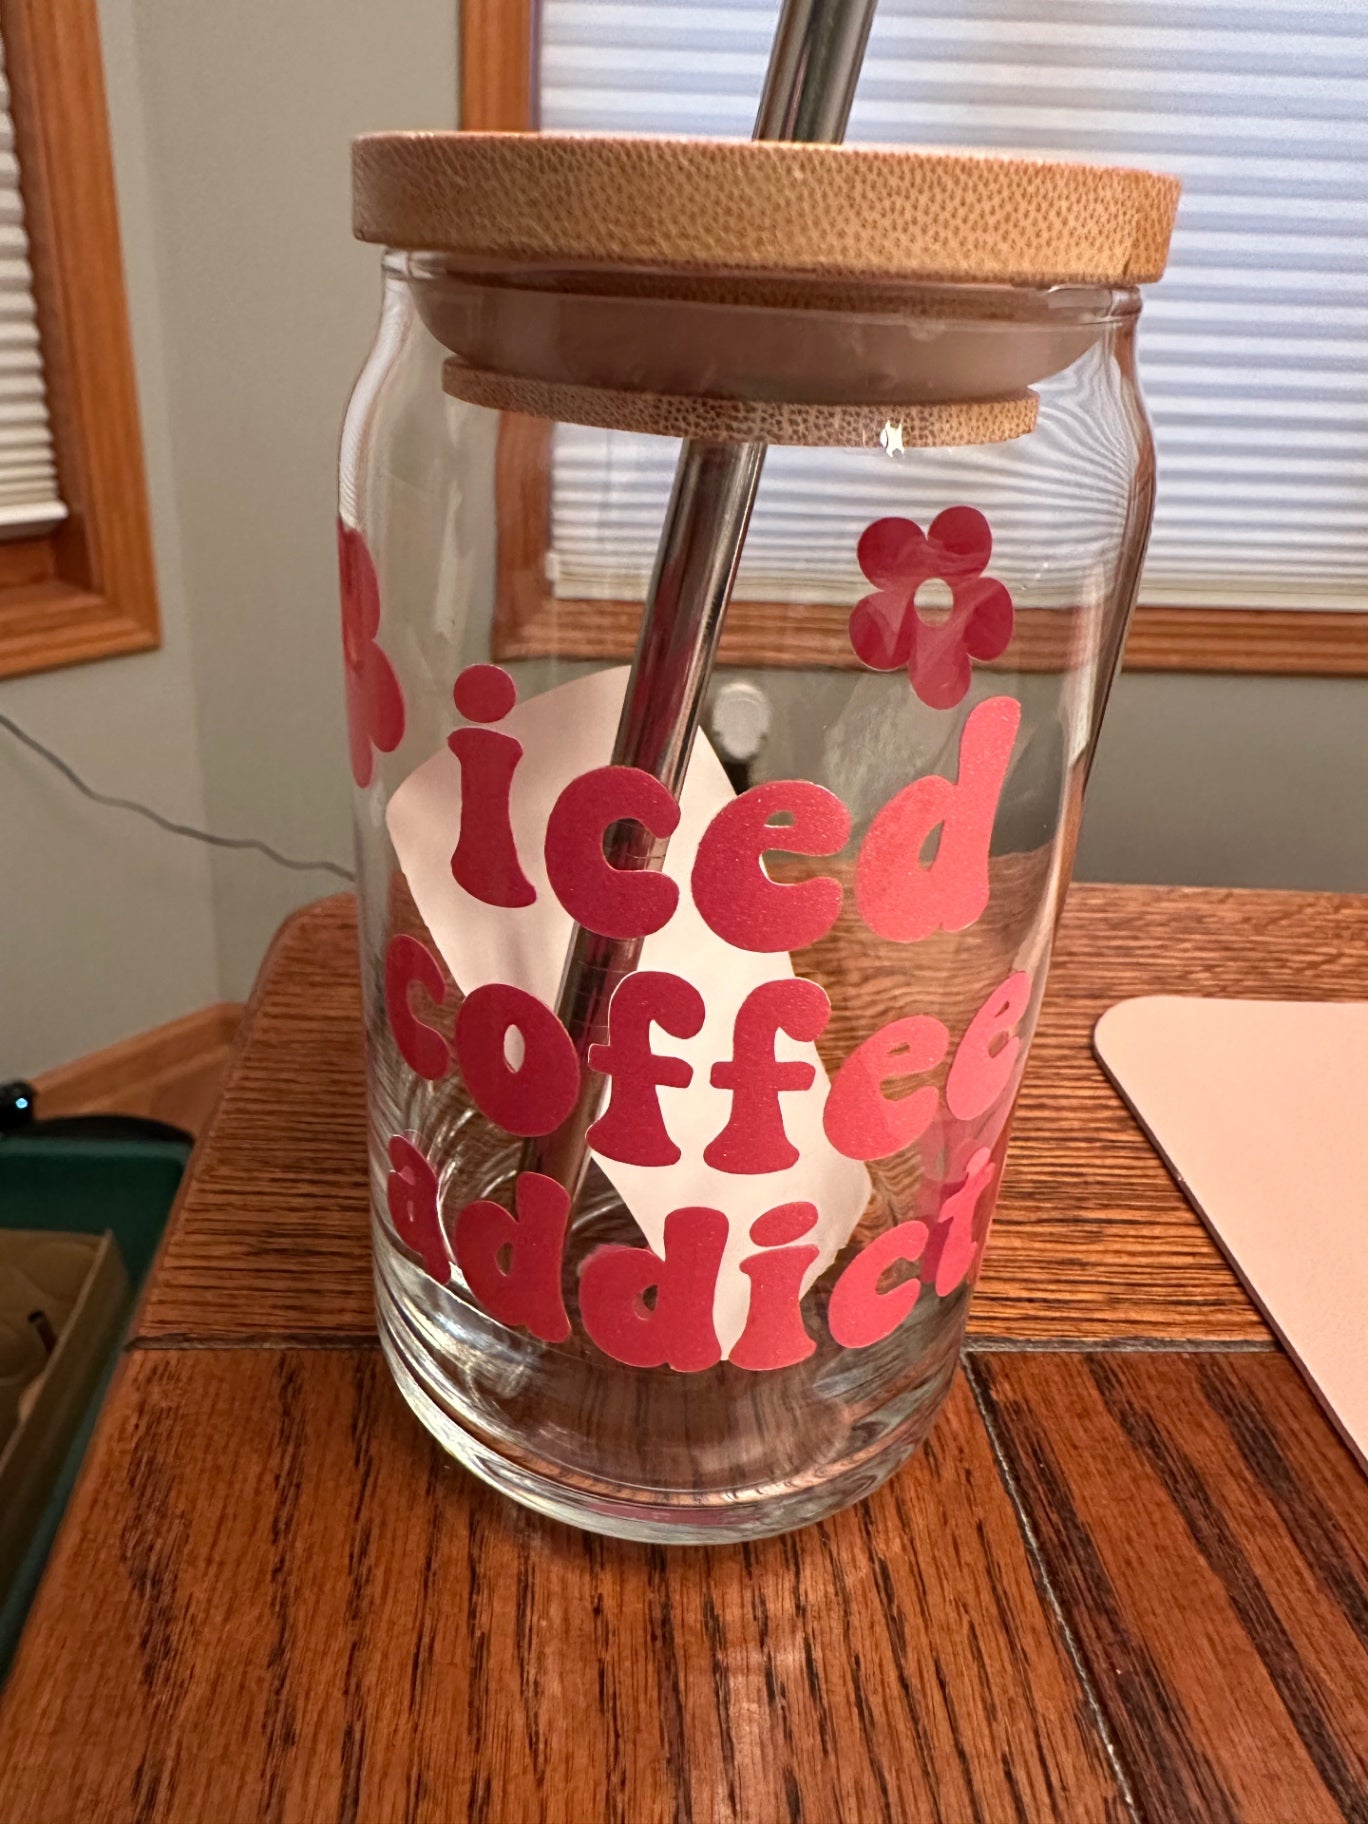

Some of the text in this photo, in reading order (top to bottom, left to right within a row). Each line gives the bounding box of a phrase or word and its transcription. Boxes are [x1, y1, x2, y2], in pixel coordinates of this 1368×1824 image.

[448, 664, 1021, 952] iced
[385, 970, 1030, 1175] coffee
[387, 1134, 995, 1373] addict
